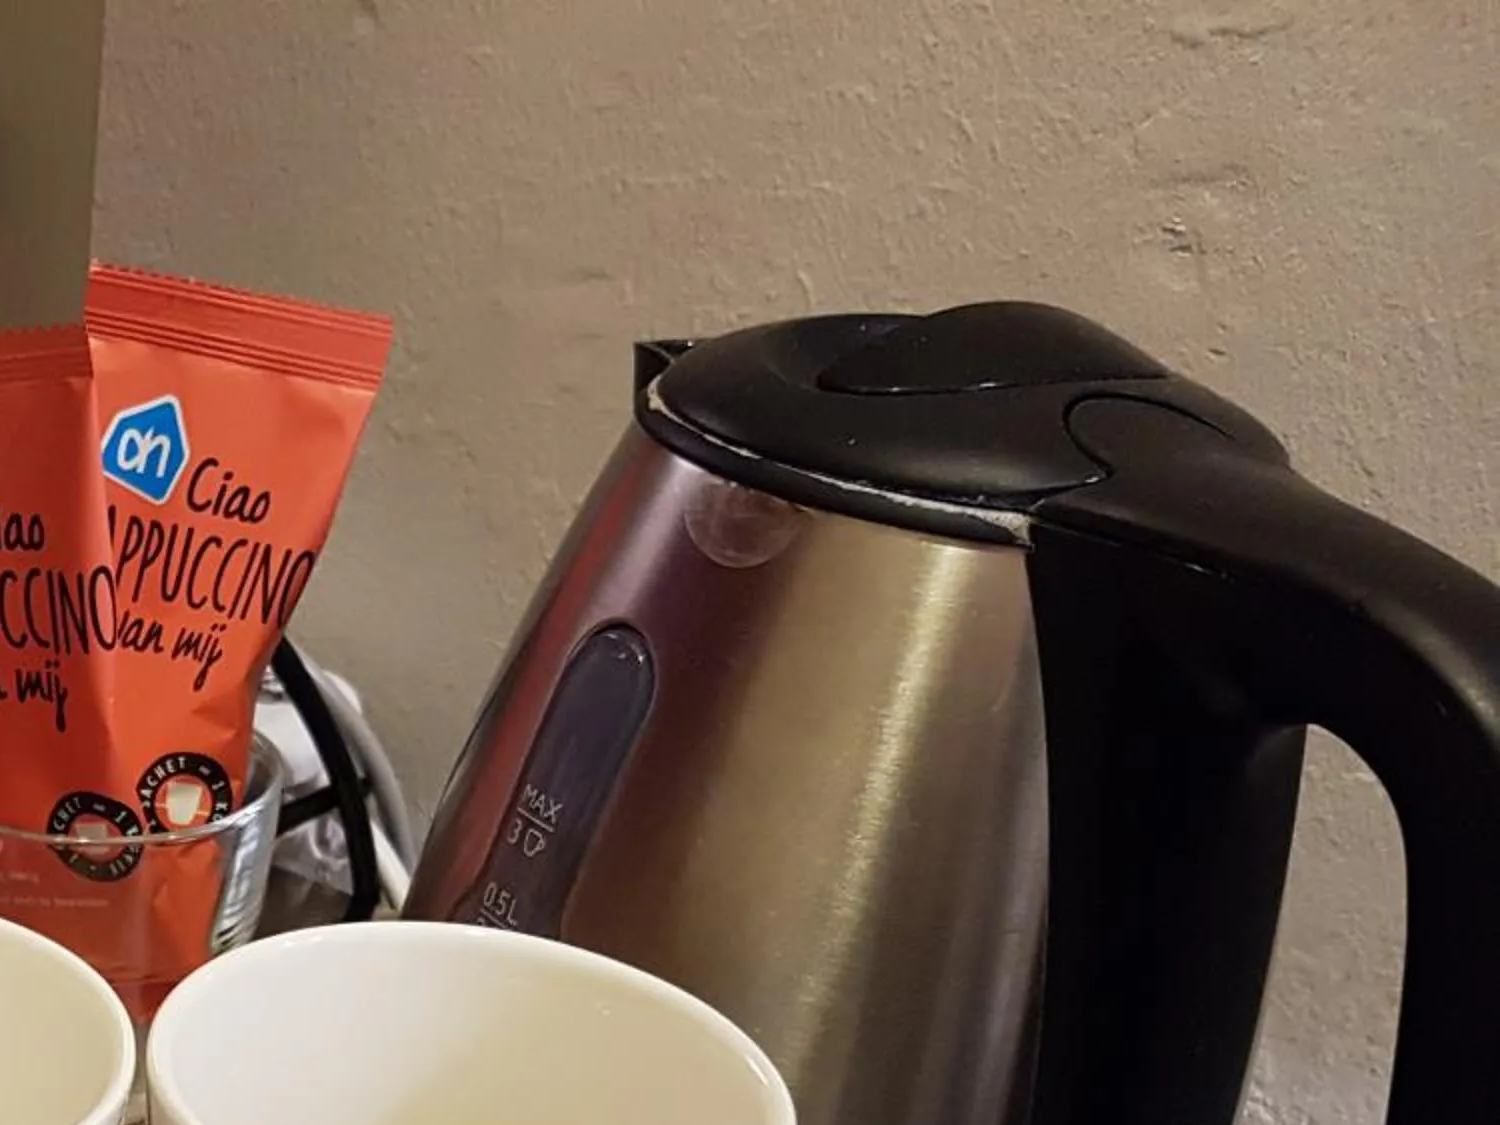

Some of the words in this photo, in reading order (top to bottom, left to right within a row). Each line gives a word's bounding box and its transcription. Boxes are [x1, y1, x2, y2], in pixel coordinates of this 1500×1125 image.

[186, 456, 271, 524] Ciao
[107, 503, 316, 629] PPUCCINO
[506, 818, 523, 845] 3
[522, 783, 564, 825] MAX
